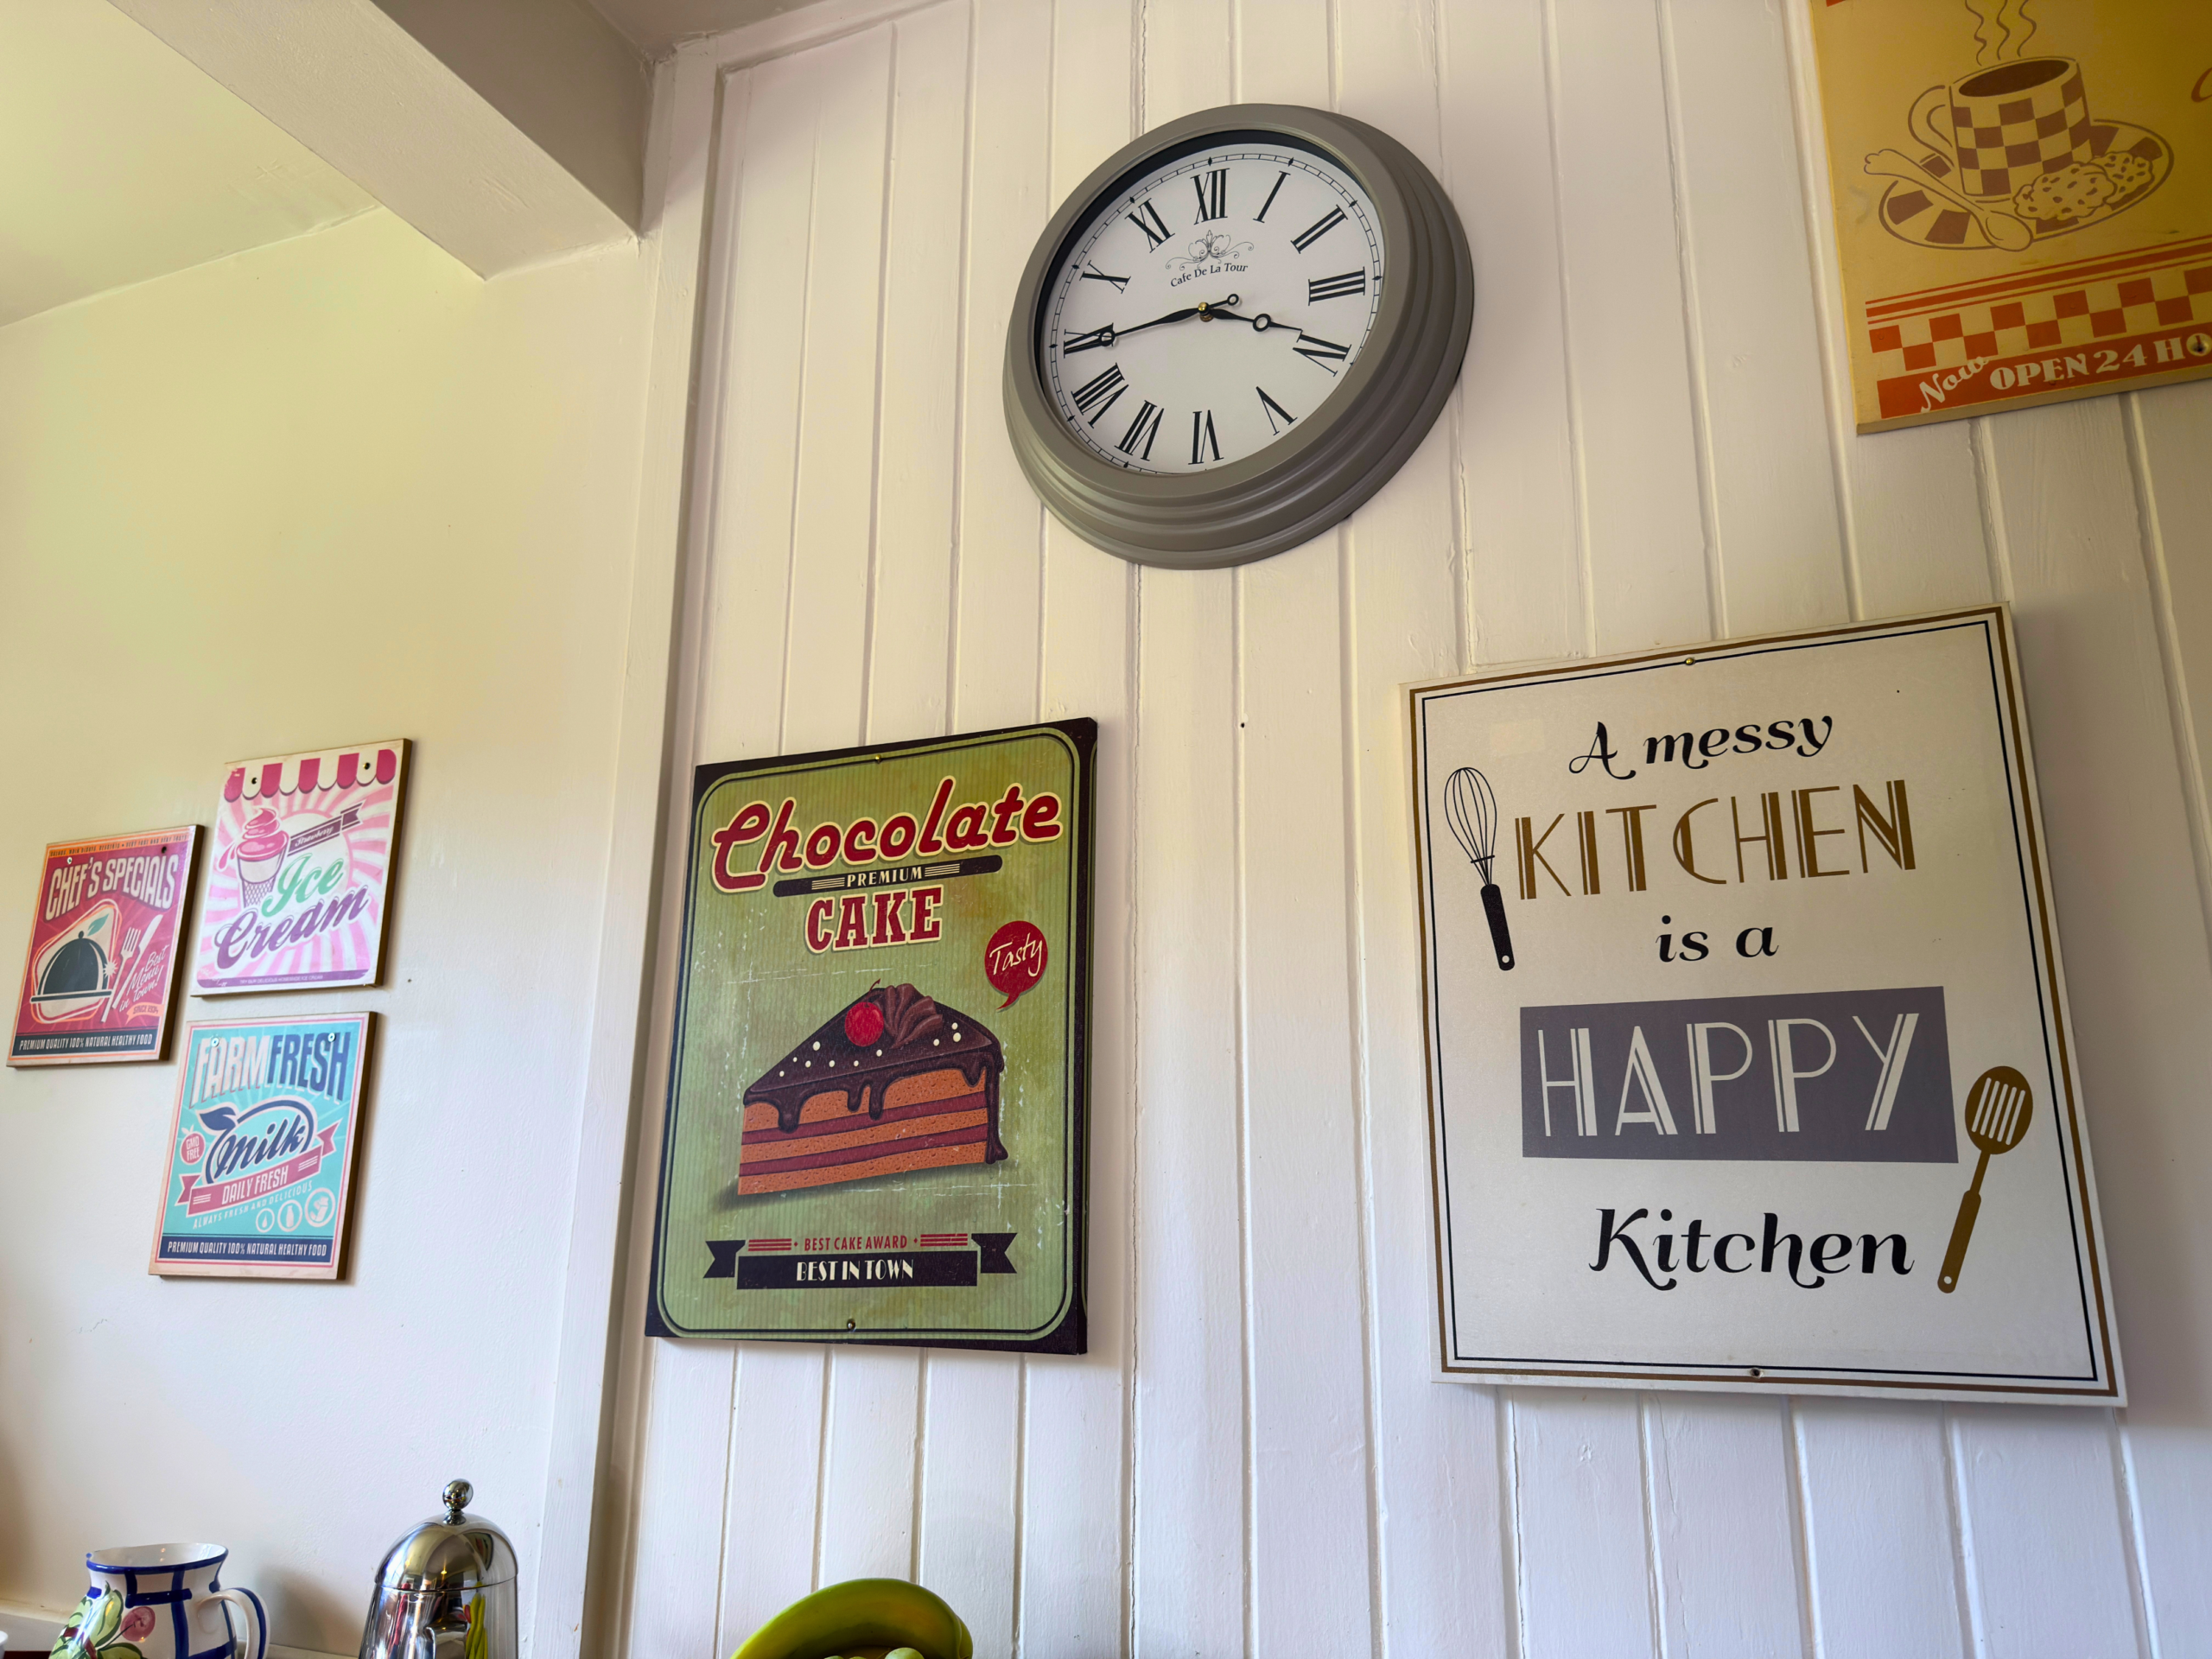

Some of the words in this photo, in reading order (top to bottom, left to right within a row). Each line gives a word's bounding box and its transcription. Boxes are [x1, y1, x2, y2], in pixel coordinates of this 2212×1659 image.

[1190, 168, 1230, 225] XII
[1253, 170, 1291, 223] I
[1124, 198, 1175, 253] XI
[1290, 204, 1348, 254] II
[1079, 260, 1131, 294] X
[1171, 273, 1192, 287] Cafe
[1194, 268, 1207, 278] De
[1210, 265, 1221, 274] La
[1224, 263, 1248, 272] Tour
[1307, 266, 1365, 306] III
[1293, 330, 1352, 377] IV
[1919, 356, 1990, 413] Now
[1990, 353, 2089, 390] OPEN
[2094, 344, 2147, 373] 24
[1071, 362, 1129, 429] VIII
[1256, 386, 1298, 435] V
[1114, 400, 1164, 461] VII
[1188, 409, 1224, 465] VI
[1568, 721, 1637, 779] A
[1643, 715, 1833, 769] messy
[713, 776, 1063, 893] Chocolate
[1515, 779, 1916, 900] KITCHEN
[45, 856, 102, 920] CHEF'S
[101, 855, 179, 910] SPECIALS
[261, 853, 344, 918] Ice
[847, 867, 923, 887] PREMIUM
[215, 885, 368, 969] Cream
[806, 886, 943, 952] CAKE
[1656, 915, 1710, 963] is
[1736, 925, 1778, 959] a
[144, 944, 170, 972] Best
[990, 932, 1043, 976] Tasty
[126, 965, 160, 995] Menu
[119, 998, 129, 1013] in
[19, 1039, 46, 1051] PREMIUM
[46, 1037, 69, 1050] QUALITY
[69, 1037, 84, 1049] 100%
[86, 1035, 111, 1047] NATURAL
[111, 1034, 136, 1046] HEALTHY
[137, 1033, 153, 1046] FOOD
[189, 1035, 271, 1109] FARM
[267, 1032, 351, 1103] FRESH
[1537, 1013, 1919, 1137] HAPPY
[186, 1135, 200, 1149] GMO
[187, 1147, 200, 1162] FREE
[213, 1114, 307, 1179] milk
[193, 1212, 222, 1230] ALWAYS
[225, 1205, 249, 1219] FRESH
[251, 1198, 267, 1211] AND
[269, 1180, 313, 1205] DELICIOUS
[221, 1177, 254, 1205] DAILY
[254, 1165, 289, 1194] FRESH
[168, 1241, 199, 1253] PREMIUM
[199, 1242, 227, 1254] QUALITY
[228, 1243, 245, 1255] 100%
[246, 1243, 276, 1255] NATURAL
[278, 1243, 308, 1256] HEALTHY
[308, 1243, 327, 1256] FOOD
[804, 1237, 831, 1251] BEST
[834, 1236, 862, 1250] CAKE
[865, 1236, 907, 1249] AWARD
[1588, 1207, 1915, 1292] Kitchen
[797, 1261, 838, 1281] BEST
[842, 1260, 860, 1281] IN
[864, 1259, 913, 1281] TOWN
